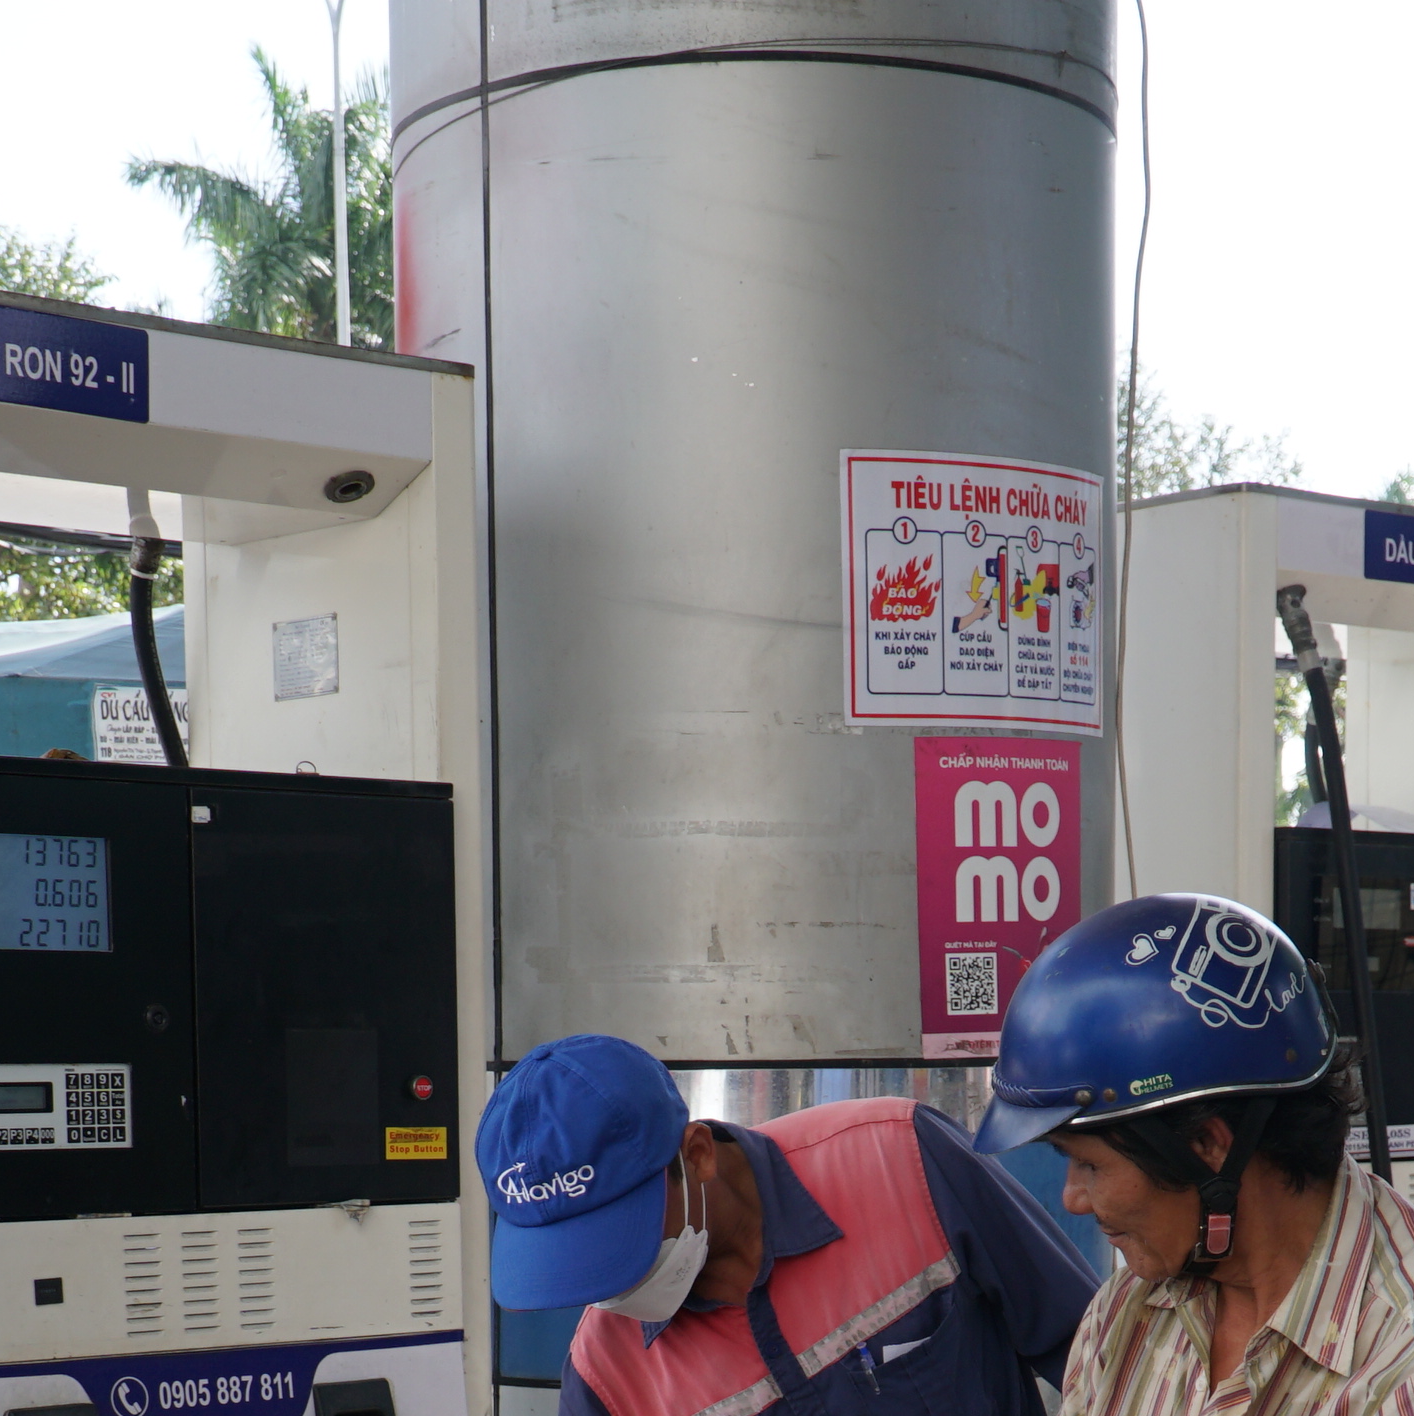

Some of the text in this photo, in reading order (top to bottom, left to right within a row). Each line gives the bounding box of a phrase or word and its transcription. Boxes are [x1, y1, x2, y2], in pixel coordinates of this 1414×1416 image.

[5, 343, 63, 384] RON
[69, 356, 99, 389] 92
[891, 474, 1088, 527] TIÊU LỆNH CHỮA CHÁY
[900, 521, 1082, 554] 1 2 3 4
[874, 631, 891, 641] KHI
[939, 753, 1069, 771] CHẤP NHẬN THANH TOÁN
[19, 918, 100, 949] 22710
[68, 1074, 77, 1085] 7
[84, 1074, 92, 1084] 8
[98, 1074, 107, 1084] 9
[69, 1092, 77, 1103] 4
[84, 1092, 92, 1102] 5
[99, 1091, 108, 1102] 6
[70, 1110, 77, 1121] 1
[85, 1110, 93, 1121] 2
[100, 1110, 108, 1120] 3
[10, 1130, 24, 1140] P3
[25, 1129, 39, 1140] P4
[100, 1129, 108, 1140] C
[389, 1131, 441, 1141] Emergency
[389, 1144, 444, 1155] Stop Button
[159, 1371, 295, 1410] 0905 887 811
